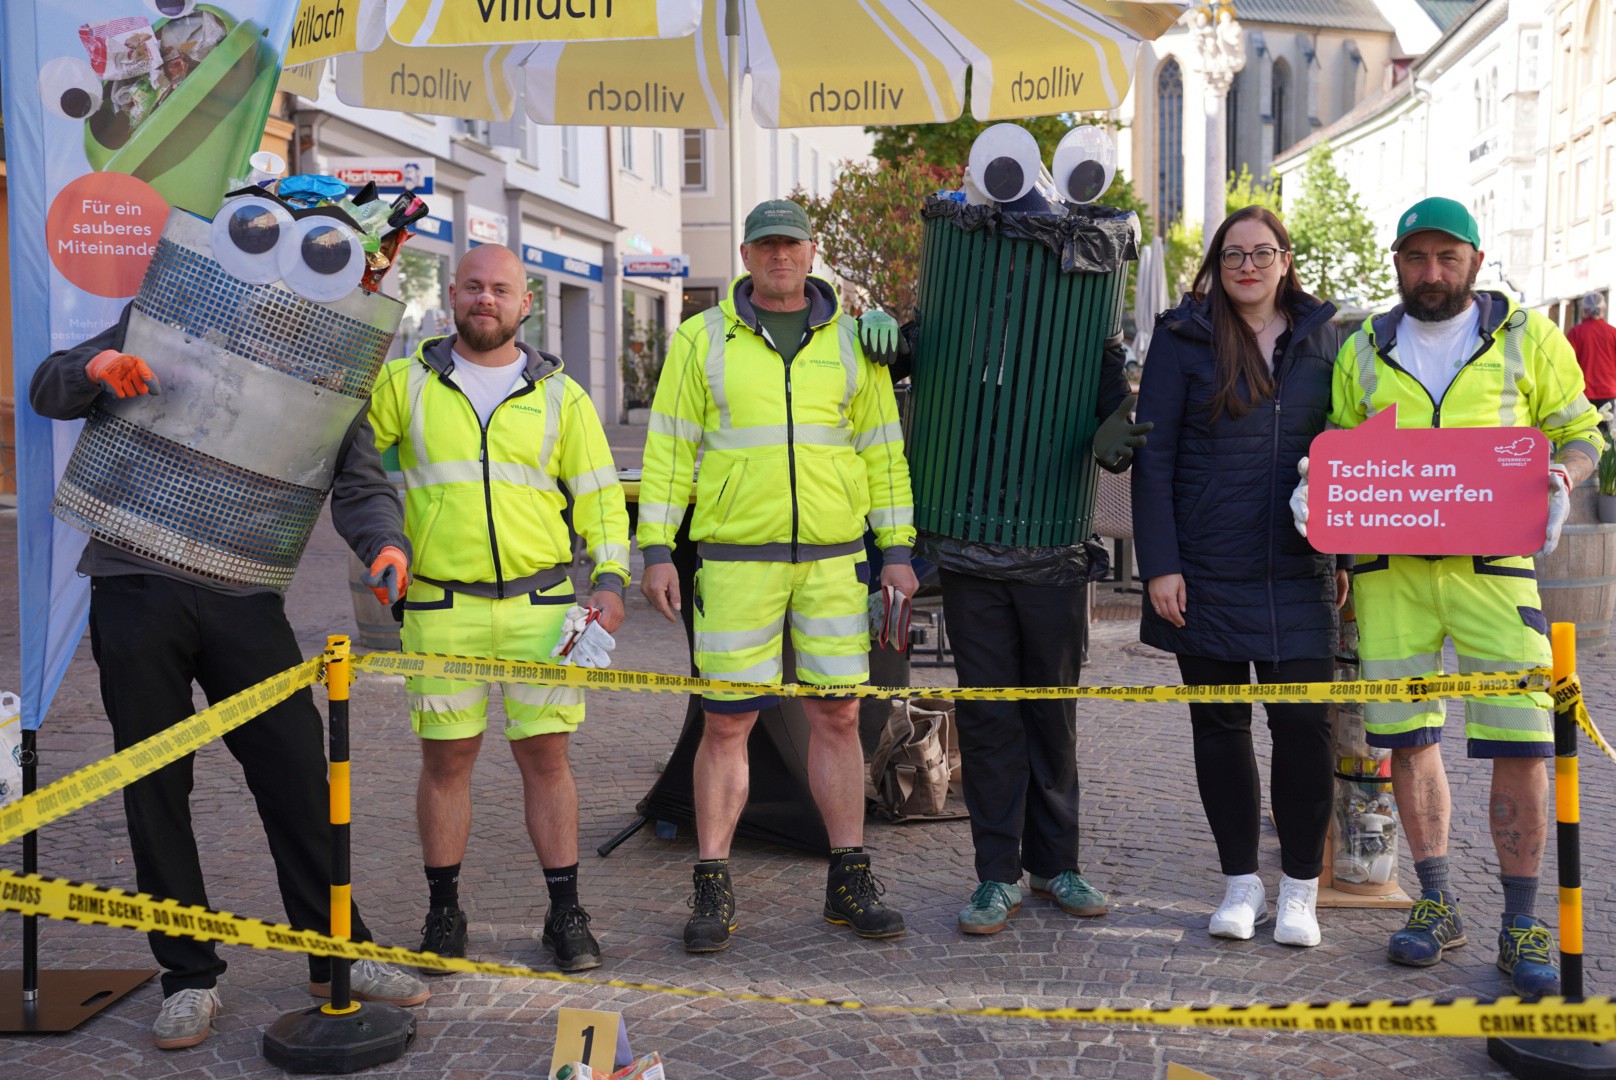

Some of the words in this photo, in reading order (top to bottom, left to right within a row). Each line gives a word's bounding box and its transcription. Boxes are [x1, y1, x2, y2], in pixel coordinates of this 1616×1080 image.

[291, 0, 345, 49] villach
[82, 199, 111, 214] Für
[115, 201, 142, 216] ein
[72, 220, 152, 236] sauberes
[58, 239, 156, 256] Miteinande
[101, 319, 118, 329] Inf
[1328, 459, 1415, 478] Tschick
[1420, 463, 1457, 478] am
[1327, 484, 1403, 503] Boden
[1408, 484, 1493, 502] werfen
[1326, 509, 1354, 527] ist
[1359, 509, 1446, 527] uncool.
[2, 881, 42, 905] CROSS
[68, 893, 105, 916] CRIME
[108, 900, 145, 921] SCENE
[153, 911, 170, 926] DO
[173, 915, 195, 932] NOT
[198, 917, 240, 938] CROSS
[1314, 1016, 1336, 1030] DO
[1341, 1016, 1373, 1032] NOT
[1379, 1015, 1437, 1033] CROSS
[1480, 1014, 1537, 1033] CRIME
[1541, 1014, 1598, 1033] SCENE
[581, 1025, 595, 1066] 1
